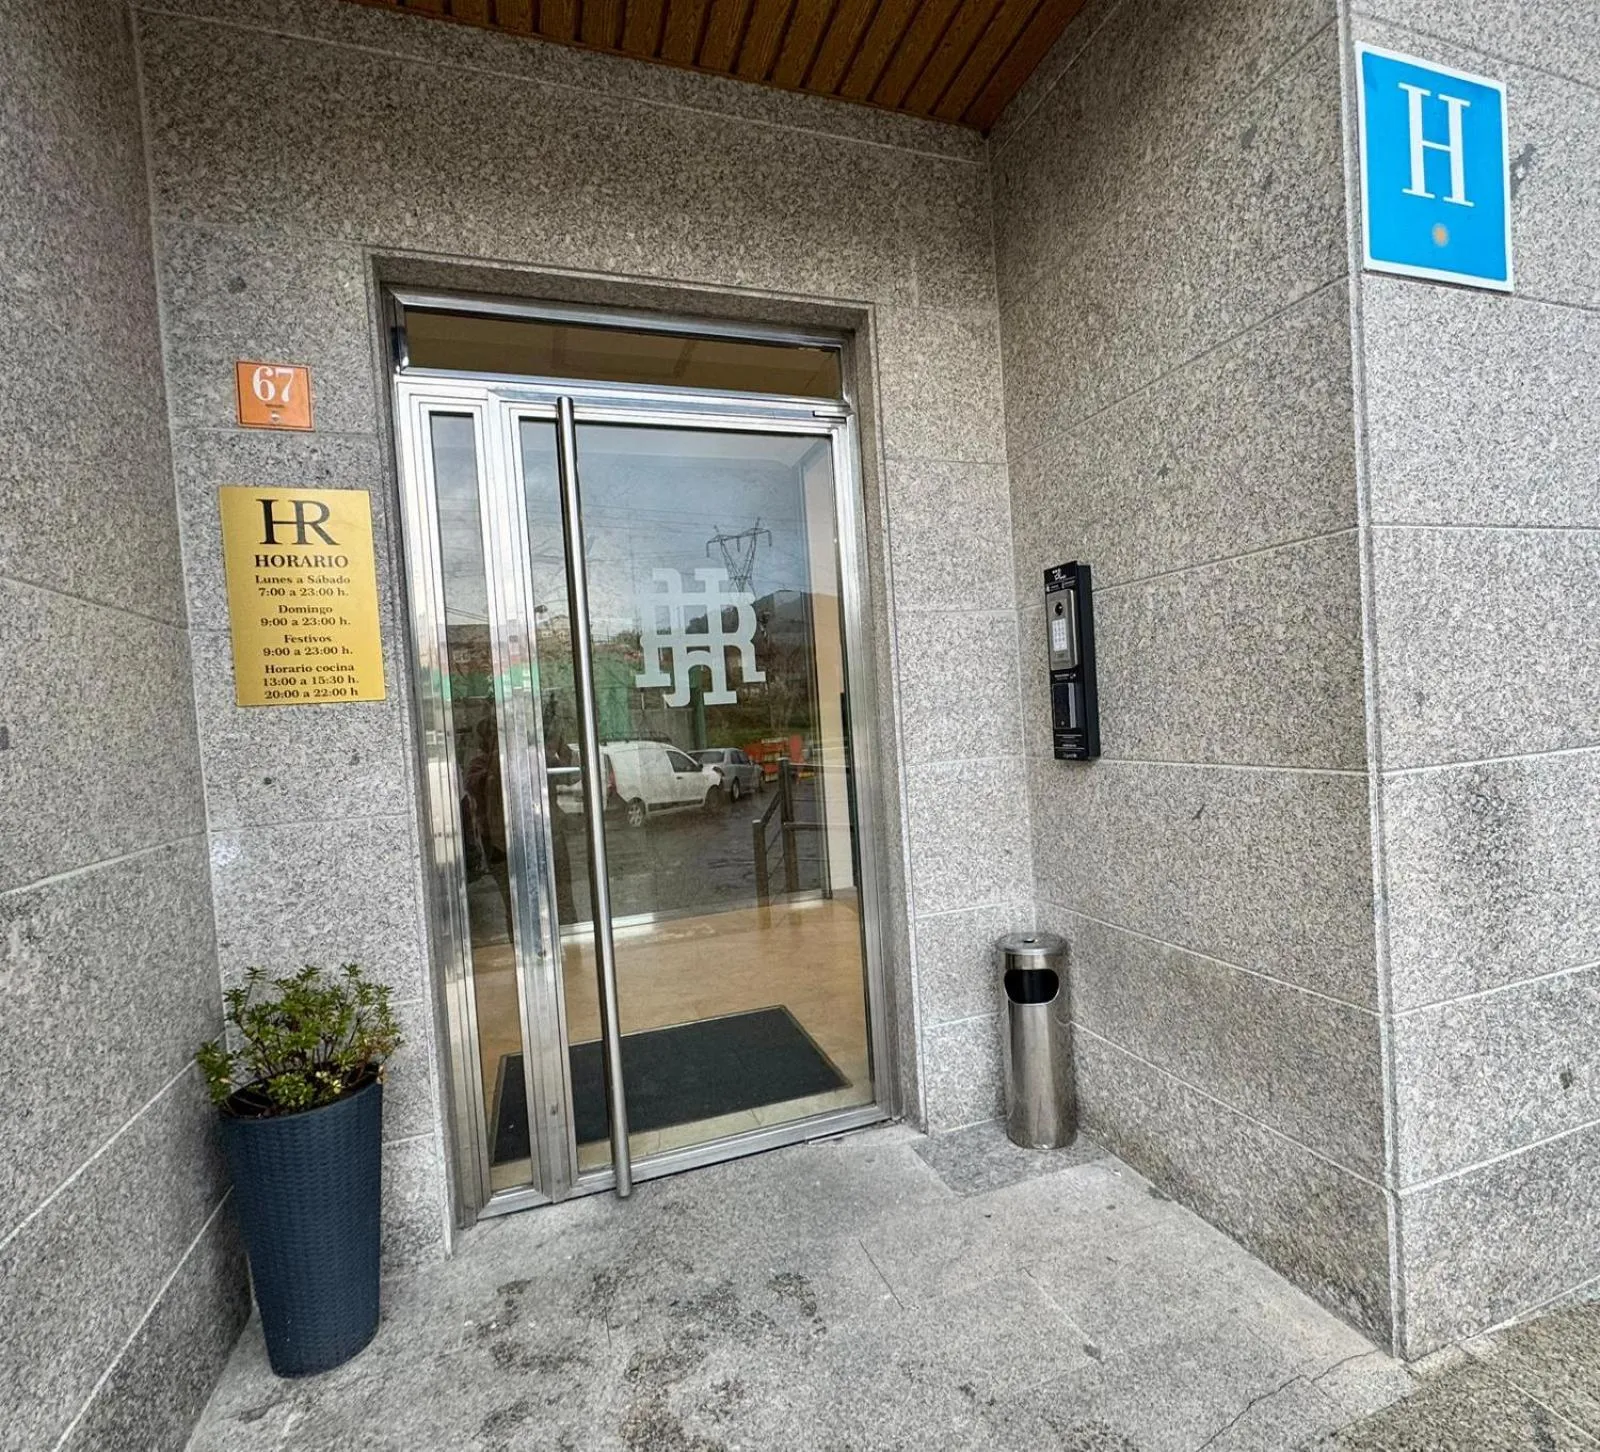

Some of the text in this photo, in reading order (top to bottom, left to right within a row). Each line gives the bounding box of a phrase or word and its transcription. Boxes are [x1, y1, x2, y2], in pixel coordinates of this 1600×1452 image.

[1398, 82, 1475, 207] H
[253, 366, 294, 403] 67
[255, 498, 341, 546] HR
[254, 554, 349, 568] HORARIO
[255, 574, 293, 584] Lunes
[307, 574, 351, 584] Sábado
[258, 587, 349, 597] 7:00 a 23:00 h.
[278, 604, 333, 615] Domingo
[260, 617, 288, 627] 9:00
[301, 617, 336, 626] 23:00
[339, 616, 351, 625] h.
[284, 634, 332, 644] Festivos
[263, 645, 353, 657] 9:00 a 23:00 h.
[265, 663, 355, 674] Horario cocina
[263, 674, 360, 687] 13:00 a 15:30 h.
[265, 689, 299, 700] 20:00
[313, 687, 347, 697] 22:00
